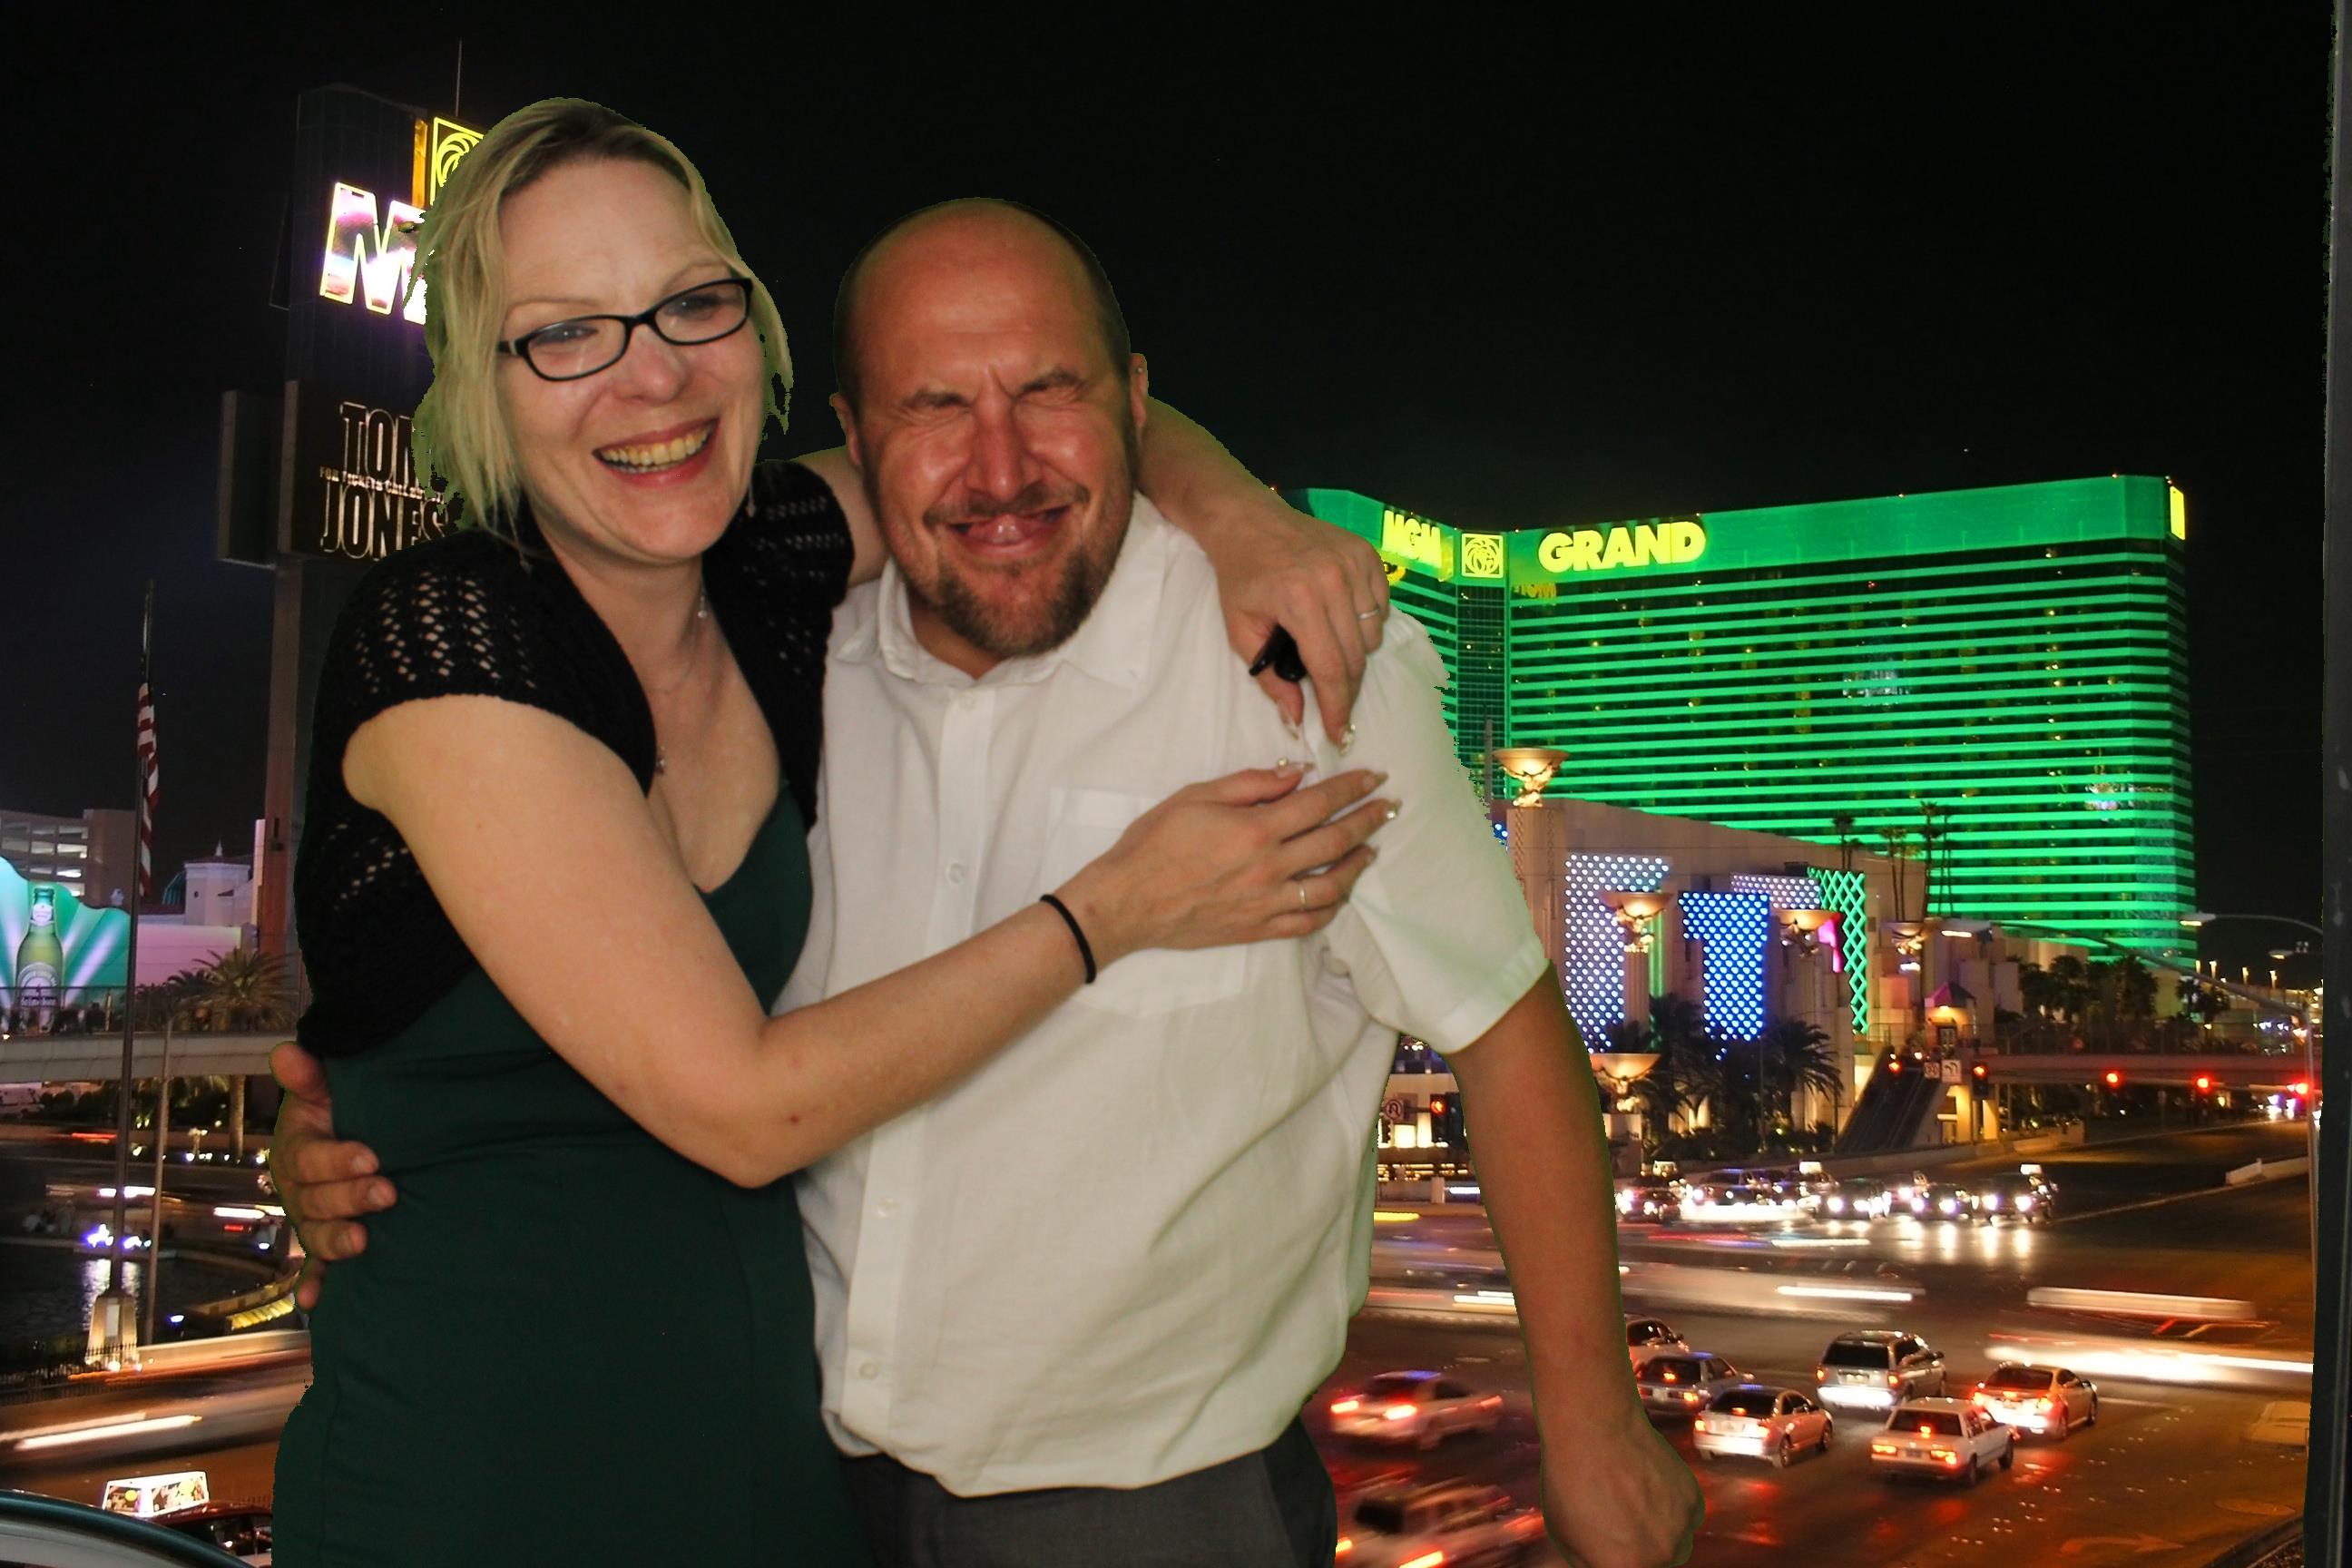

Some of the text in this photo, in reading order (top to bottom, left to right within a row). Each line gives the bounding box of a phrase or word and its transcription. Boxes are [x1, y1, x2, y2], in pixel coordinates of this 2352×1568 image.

[319, 481, 449, 561] JONES
[1381, 509, 1706, 573] MGM GRAND
